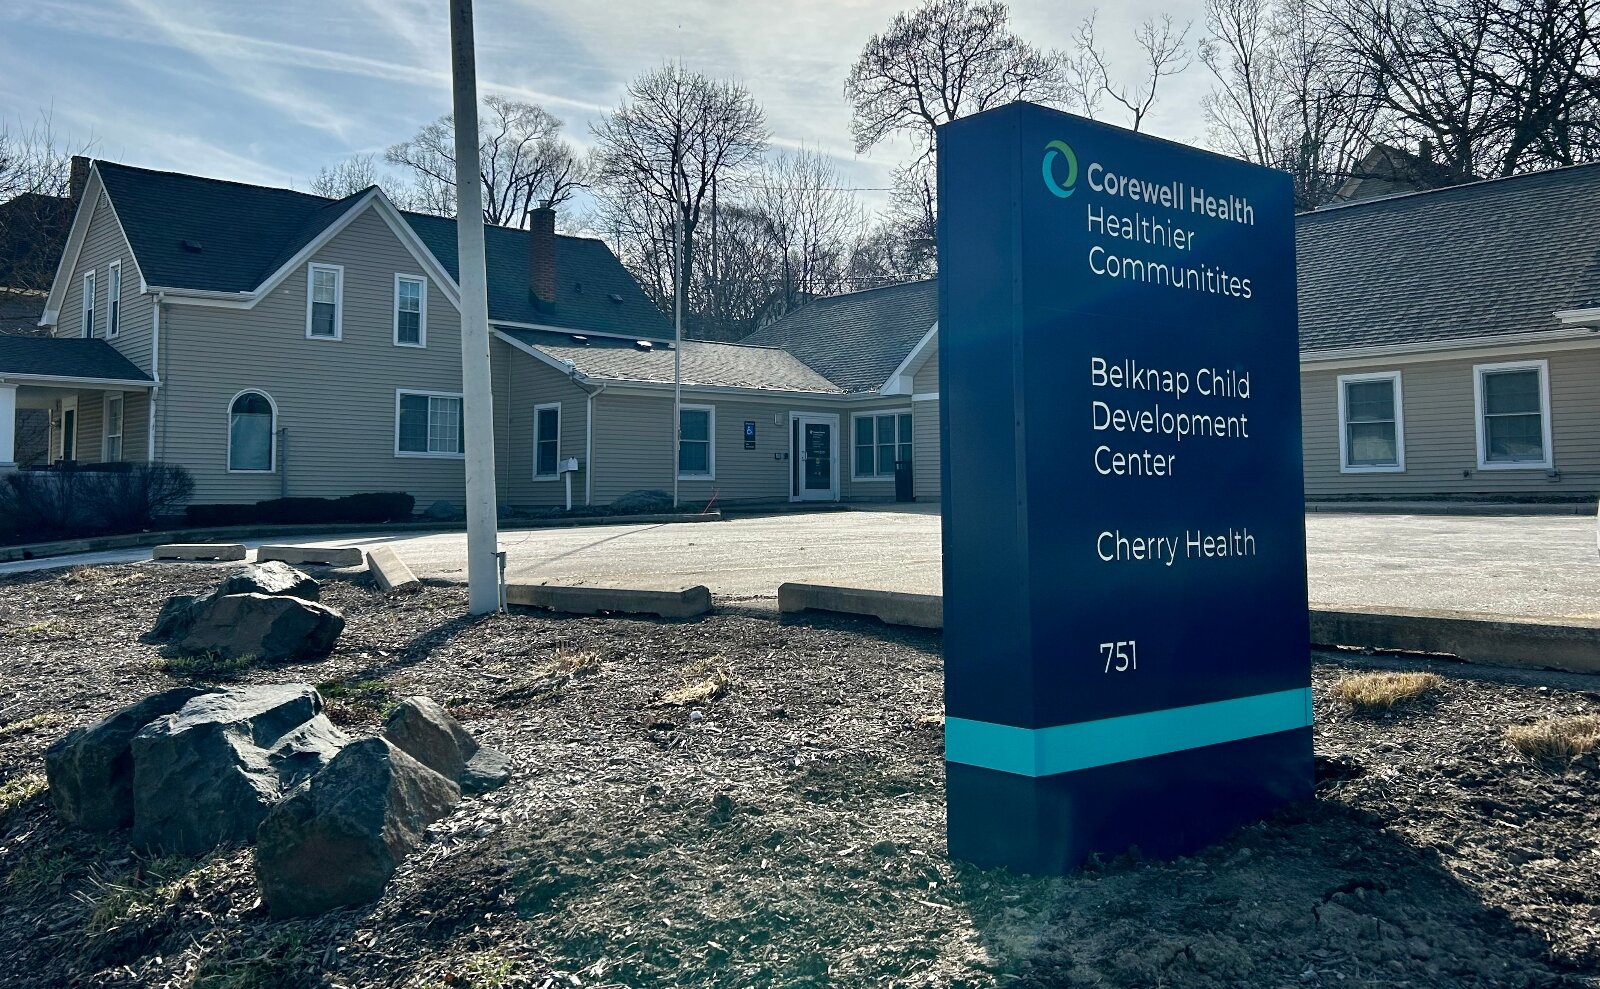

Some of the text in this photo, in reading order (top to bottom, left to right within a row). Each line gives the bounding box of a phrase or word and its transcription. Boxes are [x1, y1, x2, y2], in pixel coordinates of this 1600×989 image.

[1087, 162, 1254, 226] Corewell Health
[1087, 203, 1195, 251] Healthier
[1088, 245, 1252, 299] Communitites
[1091, 357, 1250, 400] Belknap Child
[1092, 401, 1249, 442] Development
[1094, 445, 1176, 476] Center
[1097, 527, 1256, 566] Cherry Health
[1100, 640, 1137, 673] 751
